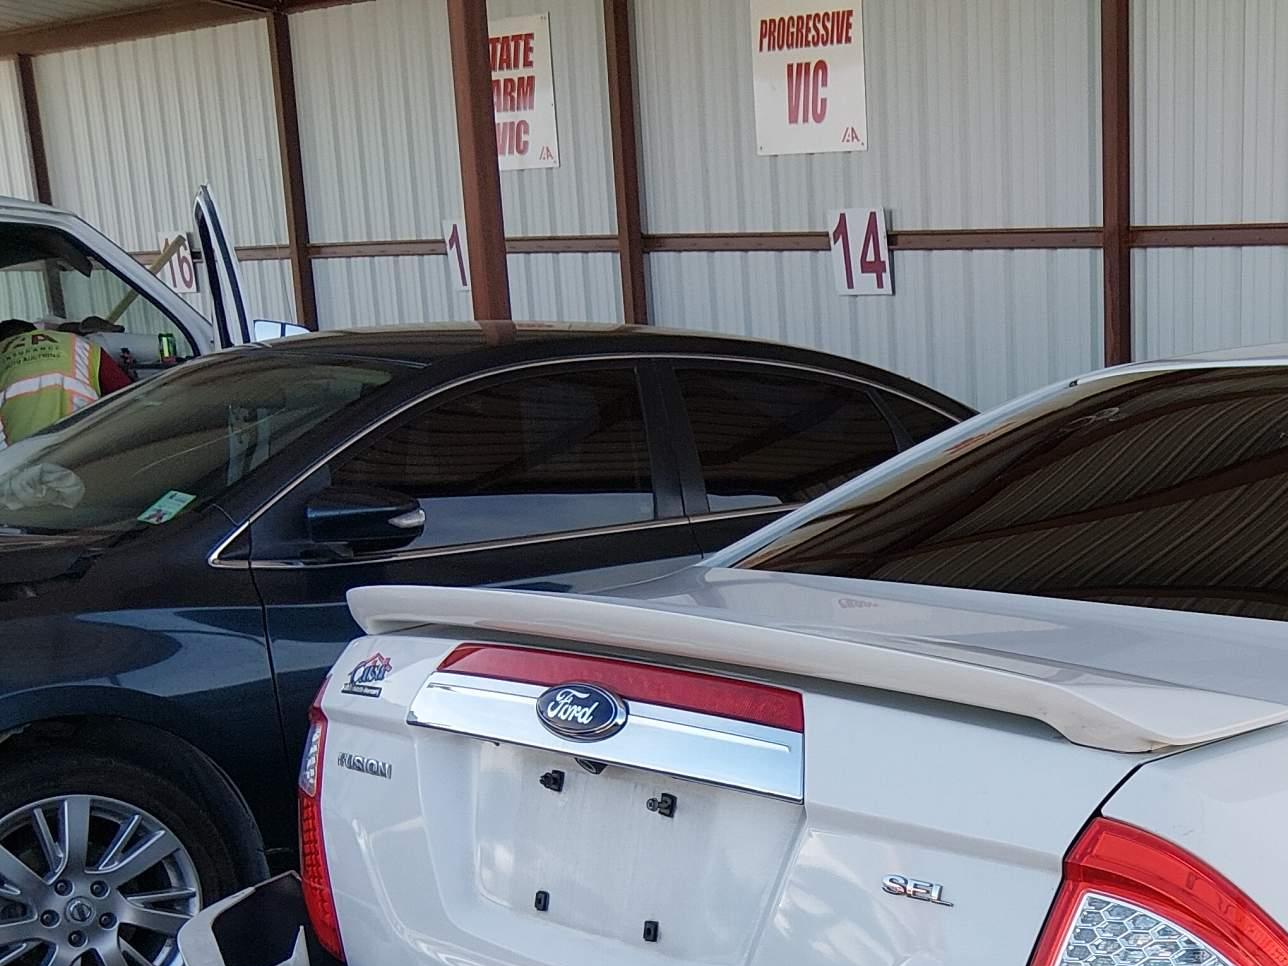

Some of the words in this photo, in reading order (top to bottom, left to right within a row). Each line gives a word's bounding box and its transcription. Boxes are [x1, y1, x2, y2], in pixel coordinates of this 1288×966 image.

[759, 10, 853, 52] PROGRESSIVE
[489, 33, 534, 72] TATE
[491, 76, 535, 113] ARM
[786, 60, 828, 124] VIC
[163, 238, 193, 288] 16
[449, 224, 467, 286] 1
[833, 211, 886, 289] 14
[547, 688, 599, 724] Ford
[881, 874, 954, 907] SEL
